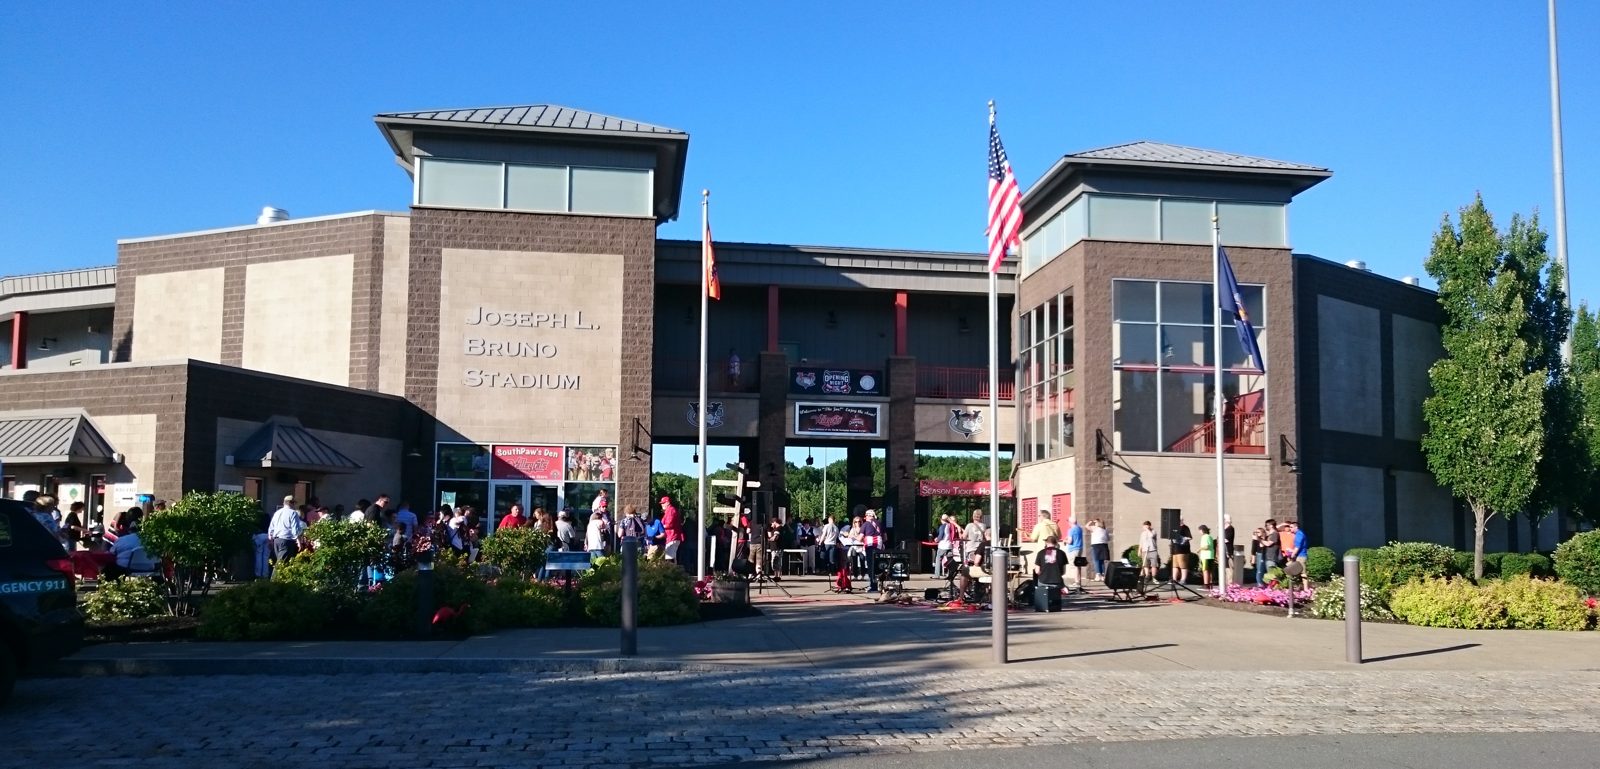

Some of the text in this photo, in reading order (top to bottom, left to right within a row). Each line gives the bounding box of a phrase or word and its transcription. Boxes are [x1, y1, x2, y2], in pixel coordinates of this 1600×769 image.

[465, 306, 601, 331] JOSEPH L.
[463, 336, 557, 358] BRUNO
[463, 368, 581, 390] STADIUM
[824, 375, 849, 383] OPENING
[497, 448, 558, 458] SouthPaw's Den
[0, 580, 65, 593] GENCY 911
